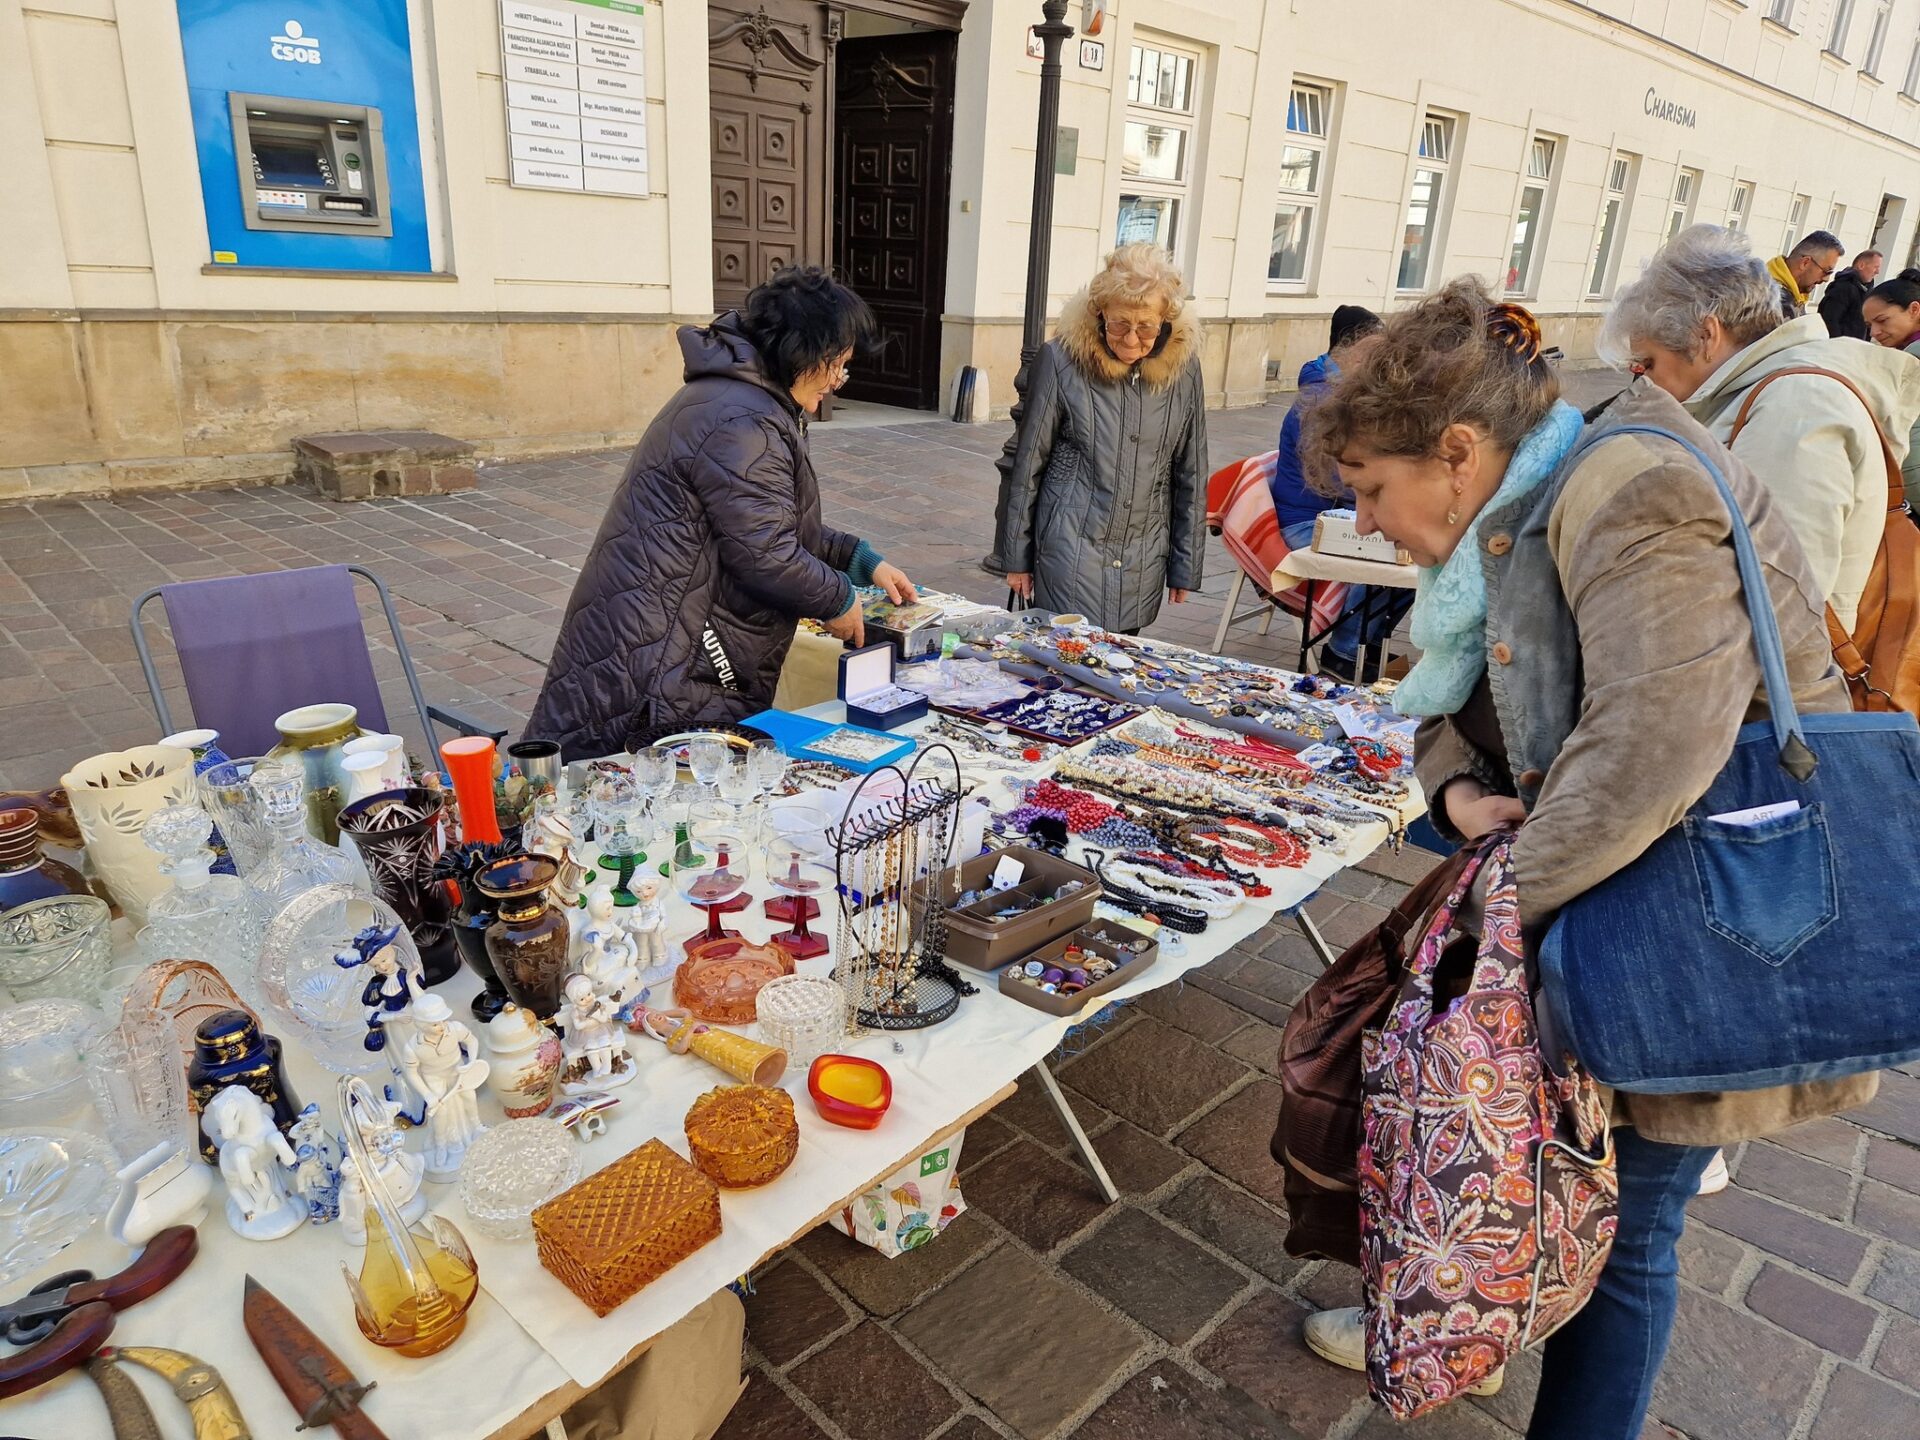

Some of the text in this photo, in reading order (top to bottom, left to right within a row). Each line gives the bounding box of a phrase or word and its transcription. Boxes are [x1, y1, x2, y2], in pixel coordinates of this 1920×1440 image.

[532, 15, 551, 25] Slovakia
[270, 43, 322, 64] ČSOB
[702, 620, 734, 685] AUTIFUL
